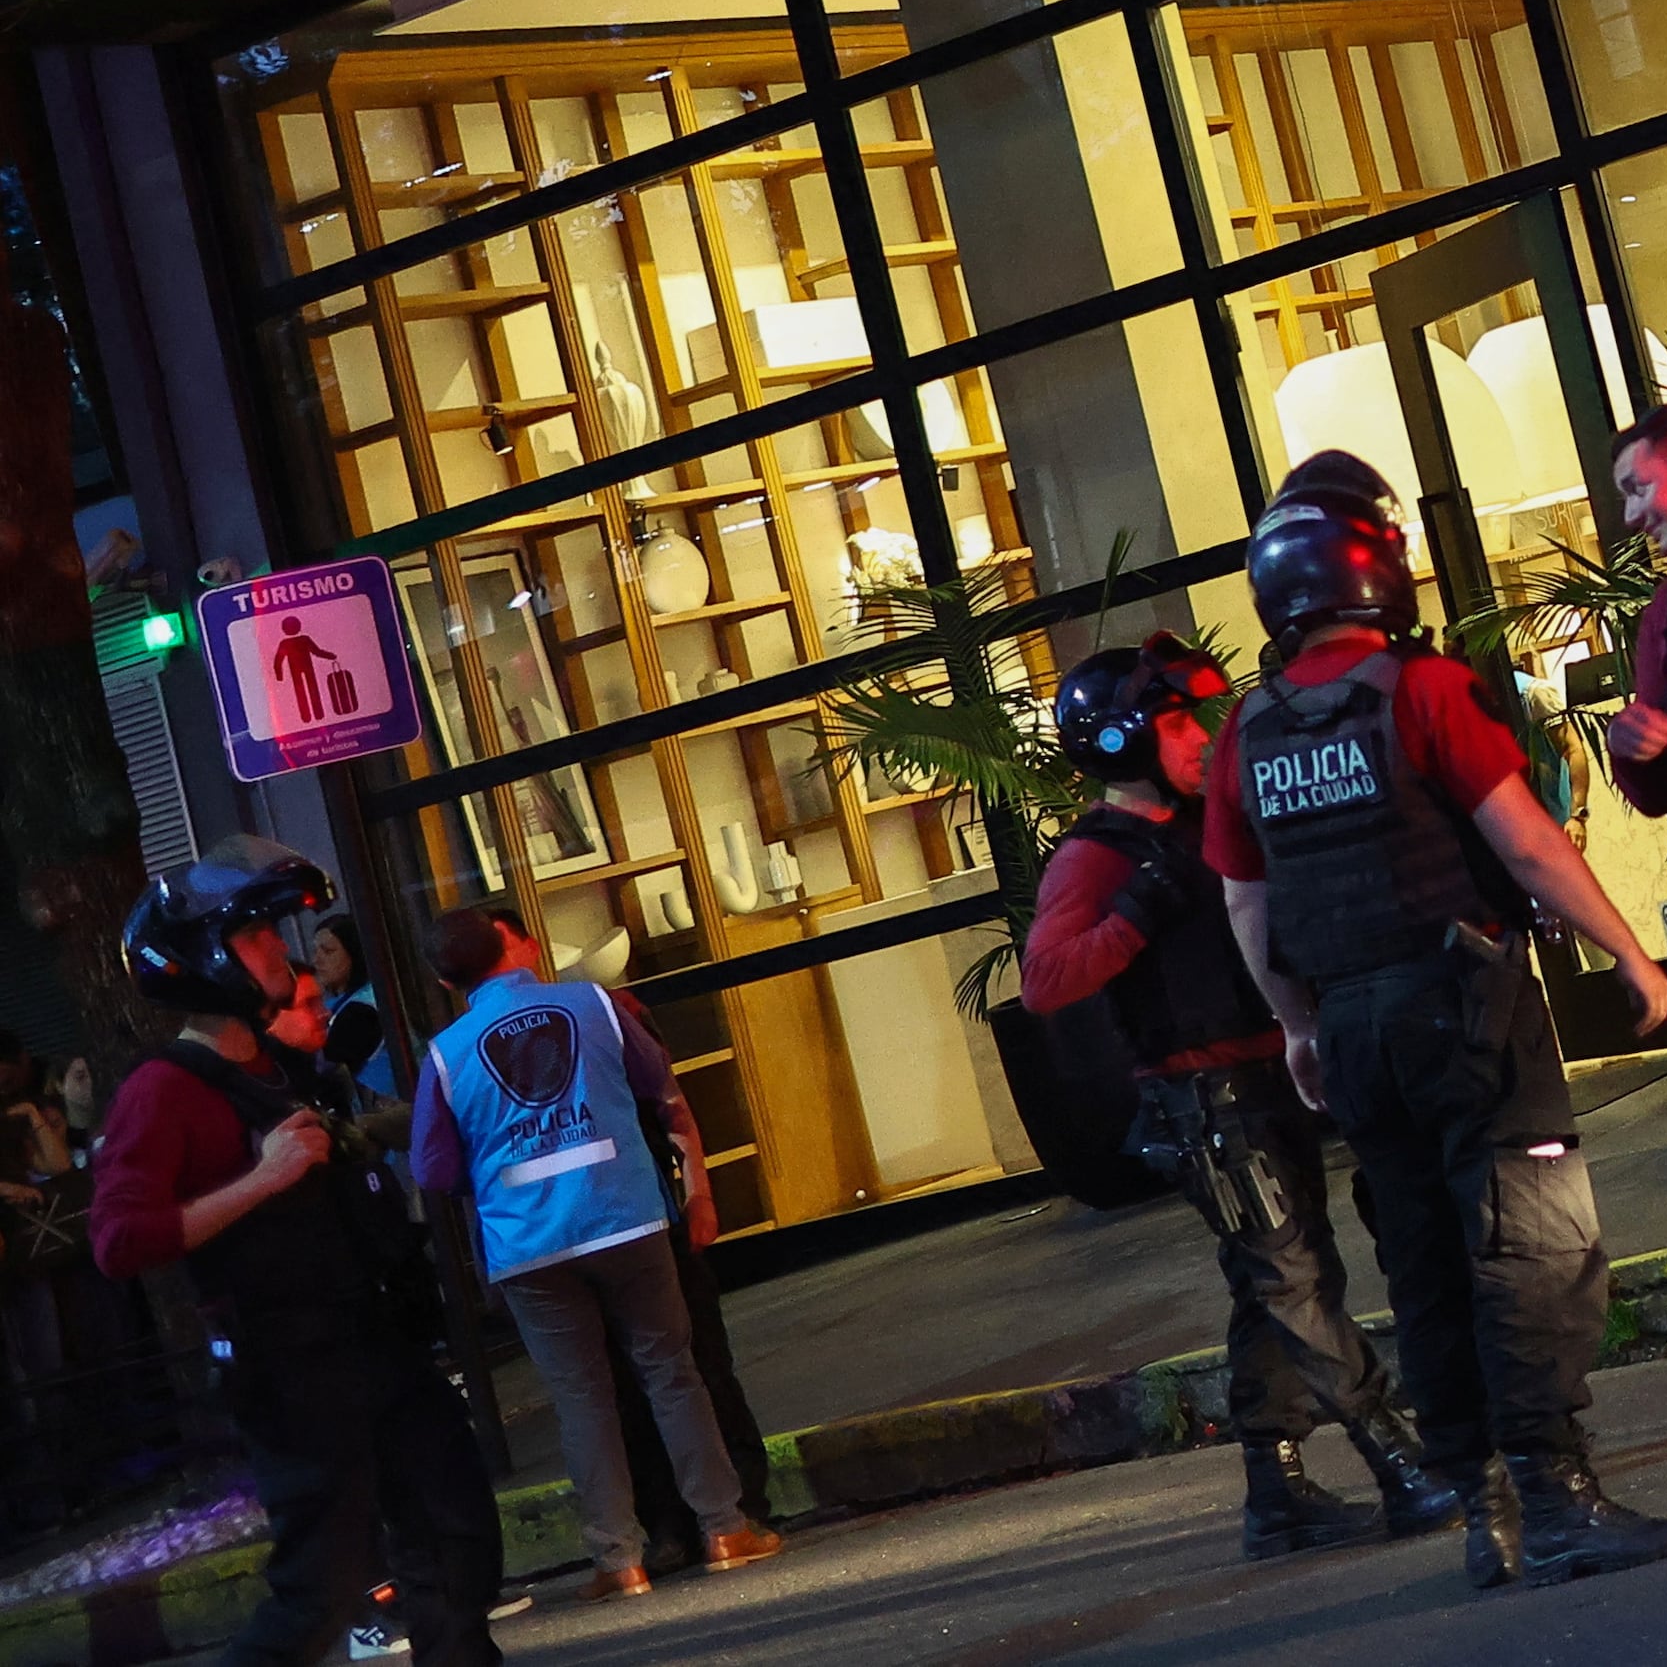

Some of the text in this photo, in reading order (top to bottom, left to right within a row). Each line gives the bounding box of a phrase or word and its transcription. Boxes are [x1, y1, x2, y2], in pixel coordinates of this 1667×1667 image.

[233, 572, 355, 613] TURISMO
[1253, 739, 1369, 797] POLICIA
[1260, 774, 1377, 818] DE LA CIUDAD
[498, 1012, 551, 1040] POLICIA
[508, 1101, 594, 1146] POLICIA
